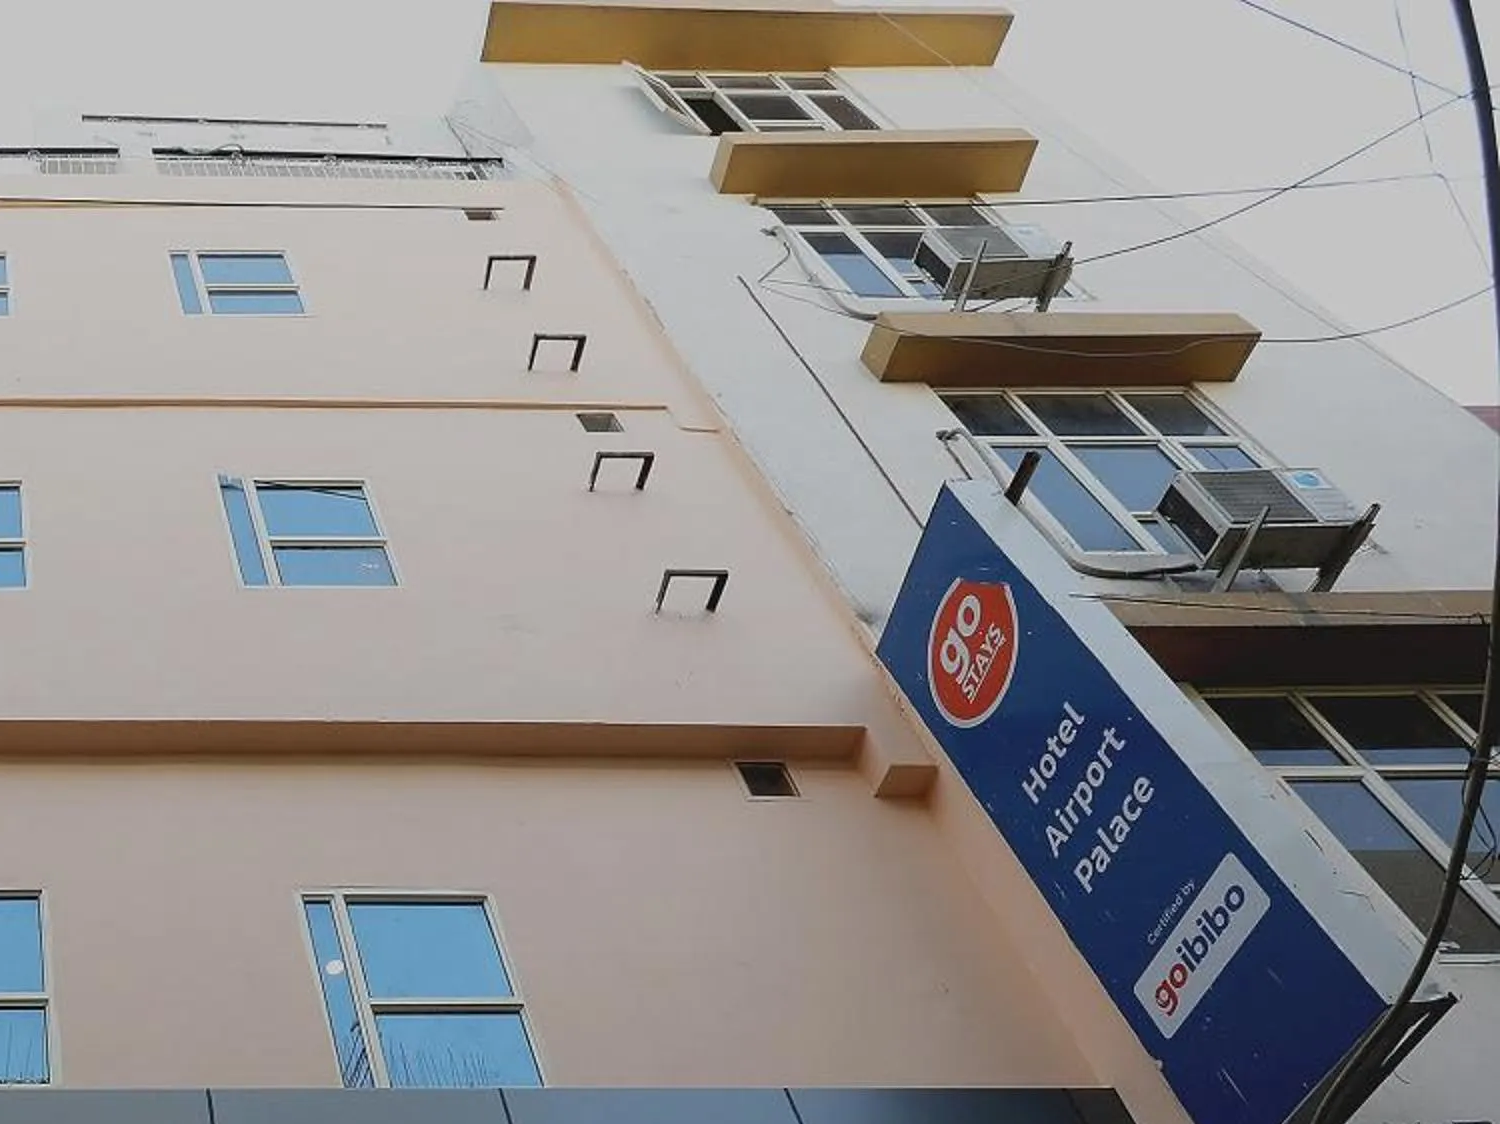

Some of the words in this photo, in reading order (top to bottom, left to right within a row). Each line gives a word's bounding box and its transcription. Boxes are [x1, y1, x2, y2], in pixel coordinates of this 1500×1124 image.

[940, 594, 980, 685] go
[961, 621, 1003, 702] STAYS
[1021, 701, 1085, 804] Hotel
[1045, 726, 1127, 859] Airport
[1073, 776, 1155, 894] Palace
[1147, 894, 1184, 945] Certified
[1180, 880, 1195, 895] by
[1155, 885, 1245, 1017] goibibo
